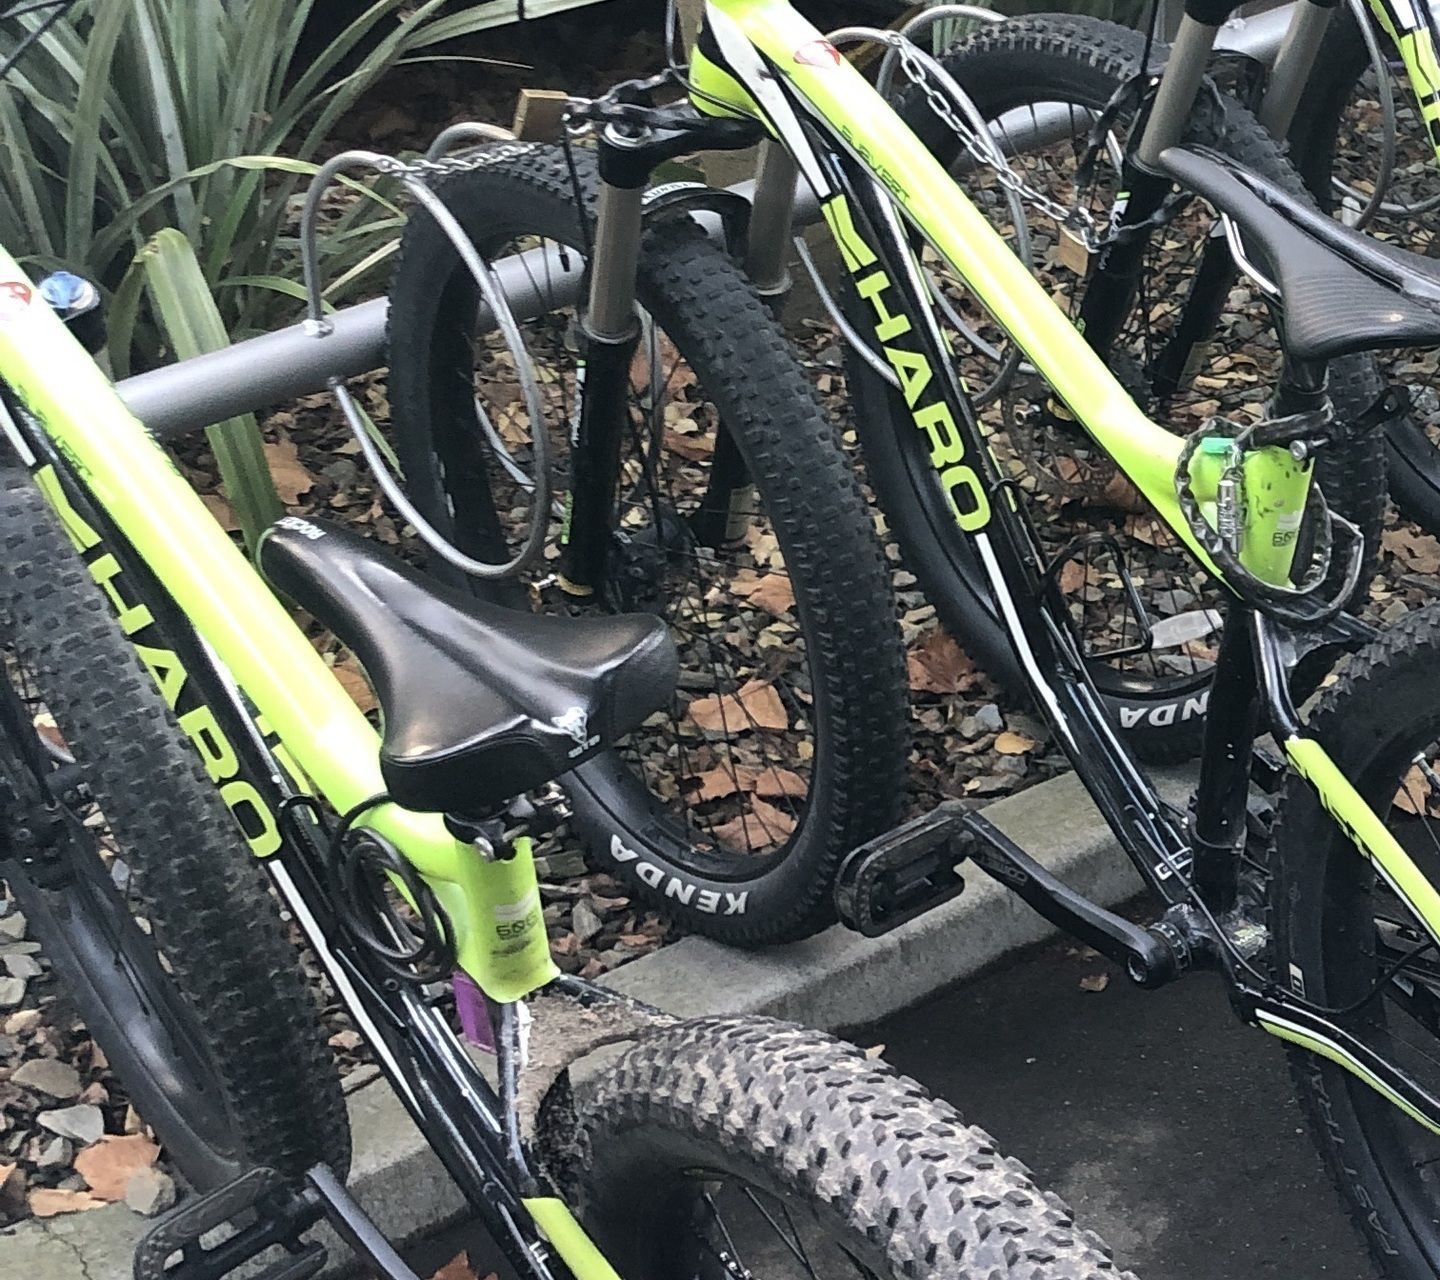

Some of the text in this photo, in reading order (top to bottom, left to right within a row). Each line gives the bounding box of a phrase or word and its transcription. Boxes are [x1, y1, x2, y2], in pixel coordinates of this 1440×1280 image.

[855, 270, 992, 532] HARO
[88, 553, 282, 858] HARO
[1120, 690, 1211, 729] NDA
[610, 834, 750, 915] KENDA
